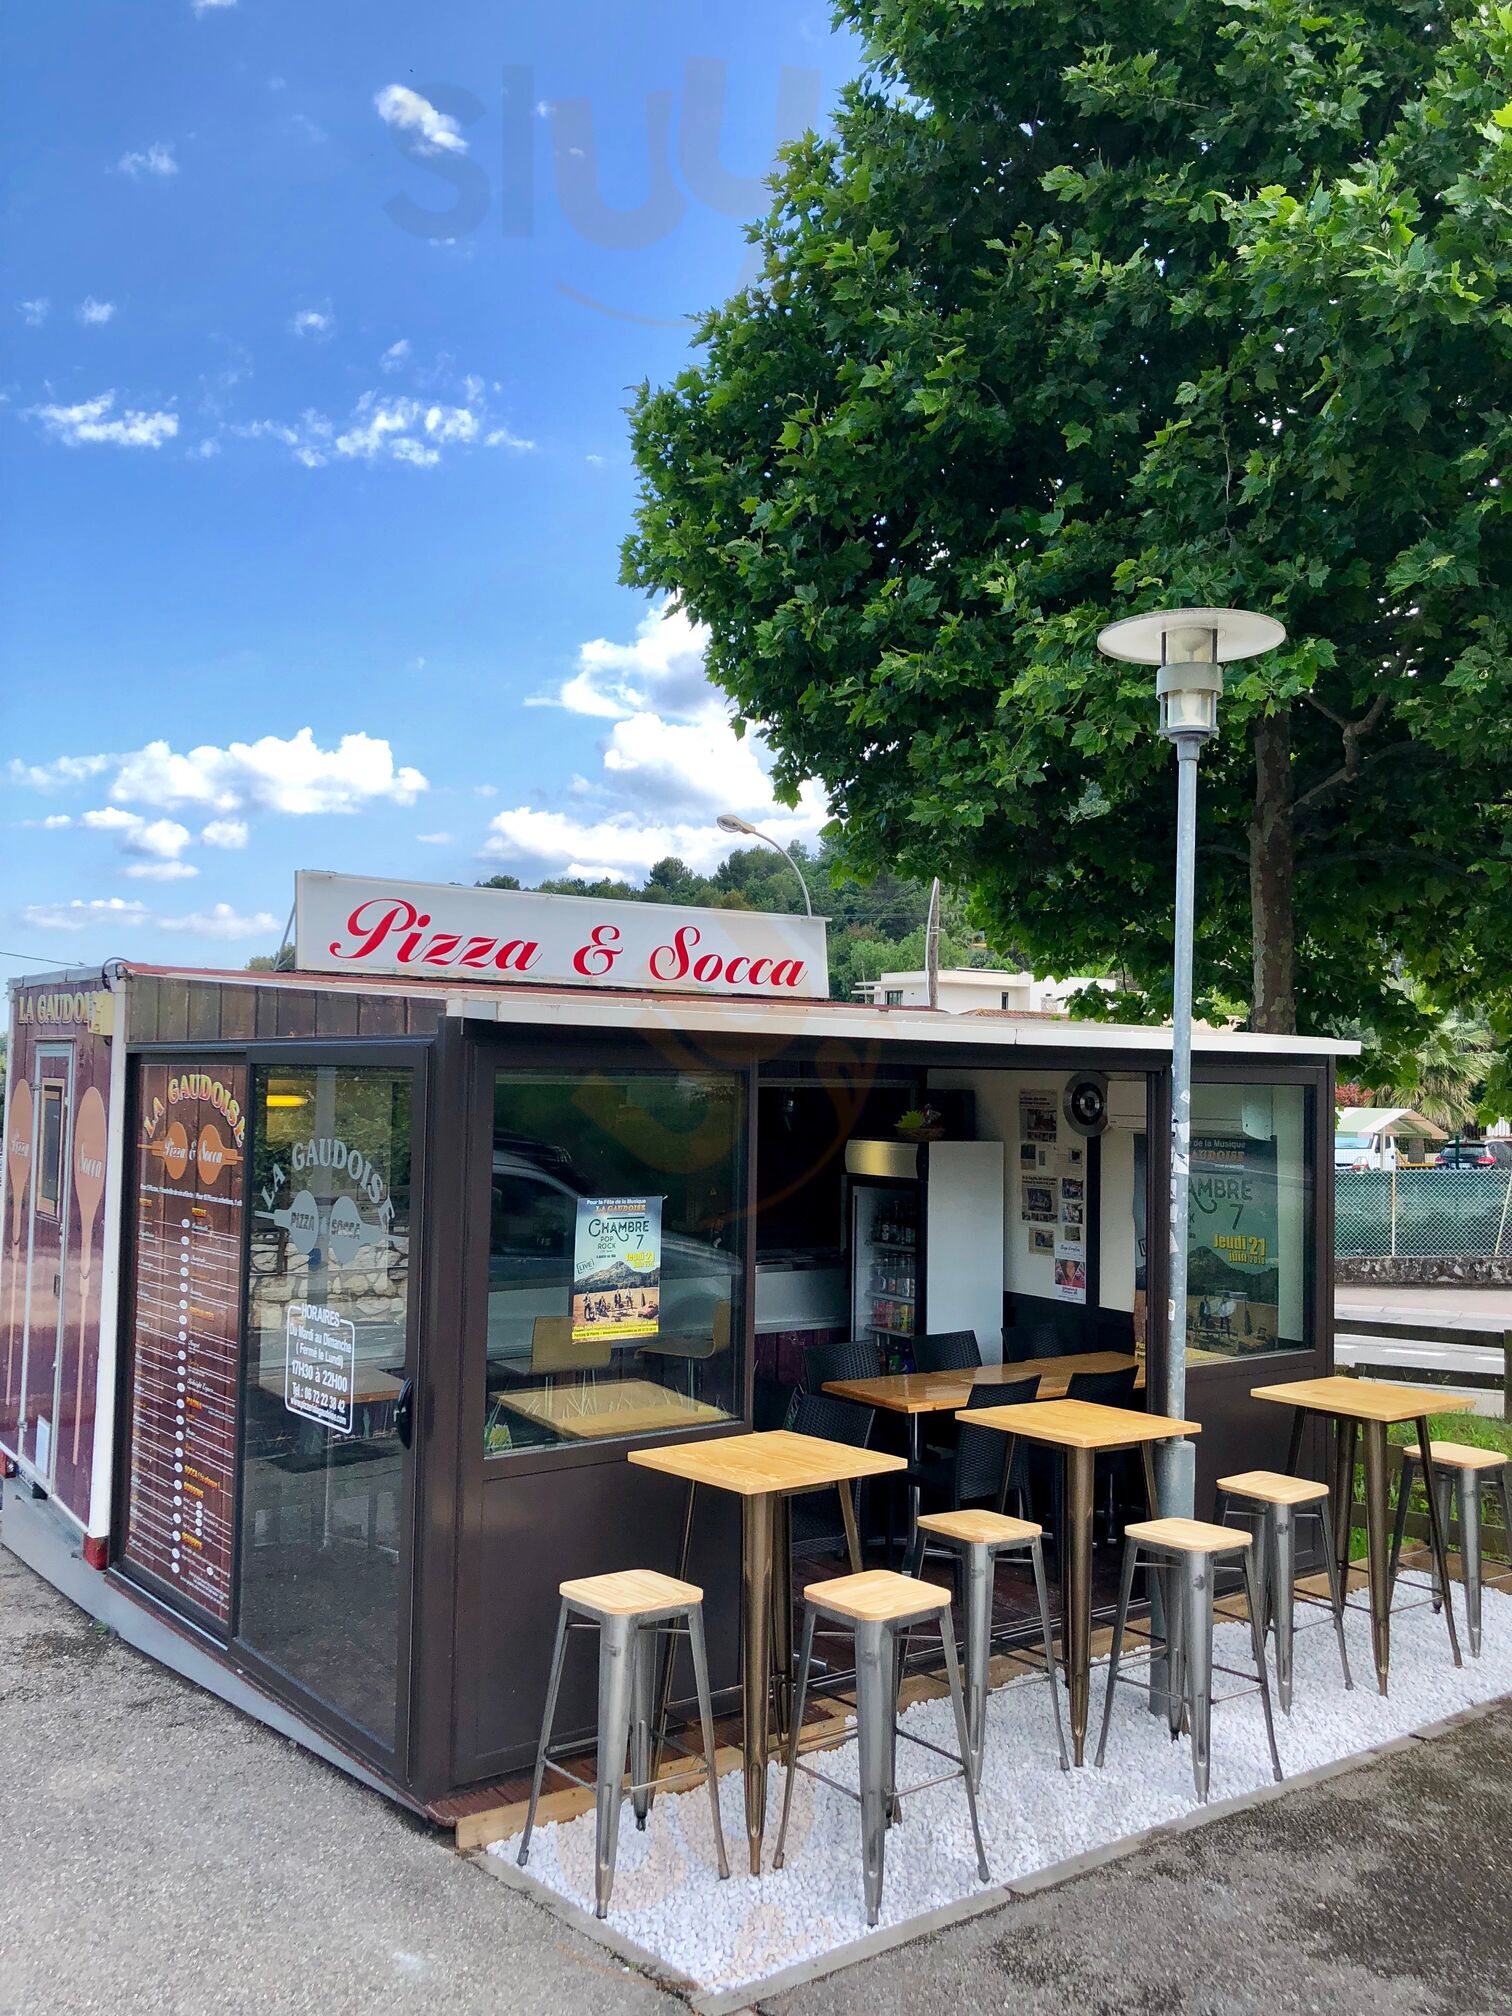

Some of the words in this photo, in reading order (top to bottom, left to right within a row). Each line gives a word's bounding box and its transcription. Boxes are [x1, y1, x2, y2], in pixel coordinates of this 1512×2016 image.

[328, 898, 543, 972] Pizza
[572, 924, 624, 977] &
[648, 925, 809, 988] Socca
[18, 996, 33, 1024] LA
[37, 989, 95, 1024] GAUDOI
[144, 1097, 165, 1138] LA
[168, 1074, 246, 1148] GAUDOISE
[1204, 1139, 1211, 1147] la
[1214, 1139, 1246, 1149] Musique
[261, 1163, 286, 1210] LA
[292, 1139, 396, 1231] GAUDOISE
[291, 1211, 315, 1231] PIZZA
[1230, 1203, 1244, 1229] 7
[636, 1234, 644, 1250] 7
[1248, 1236, 1266, 1256] 21
[578, 1261, 593, 1271] LIVE
[301, 1303, 340, 1328] HORAIRES
[289, 1322, 298, 1337] Du
[298, 1324, 314, 1343] Mardi
[314, 1333, 322, 1344] au
[323, 1332, 352, 1354] Dimanche
[291, 1360, 313, 1381] 17H30
[315, 1366, 321, 1383] à
[322, 1370, 348, 1392] 22H00
[304, 1386, 312, 1401] 06
[312, 1389, 320, 1404] 72
[321, 1392, 329, 1407] 22
[337, 1399, 346, 1414] 42
